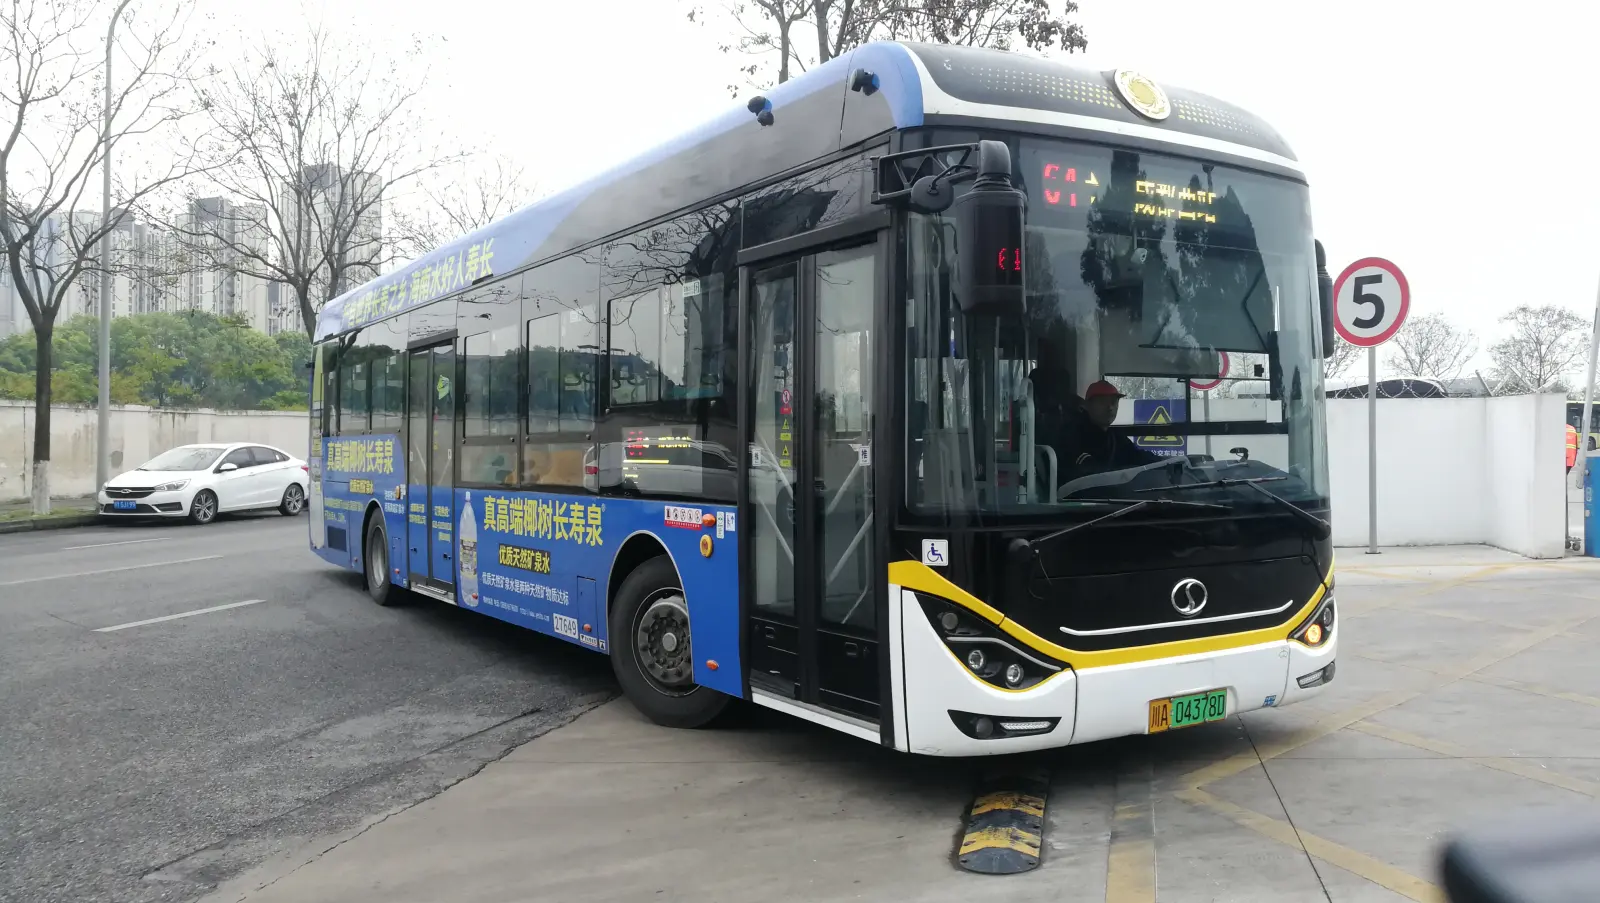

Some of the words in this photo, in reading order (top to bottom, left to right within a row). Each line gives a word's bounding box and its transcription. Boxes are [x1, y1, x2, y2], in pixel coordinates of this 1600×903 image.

[1352, 274, 1385, 329] 5
[484, 495, 603, 546] 真高端椰树长寿泉
[499, 546, 550, 573] 优质天然矿泉水
[555, 616, 577, 635] 27649
